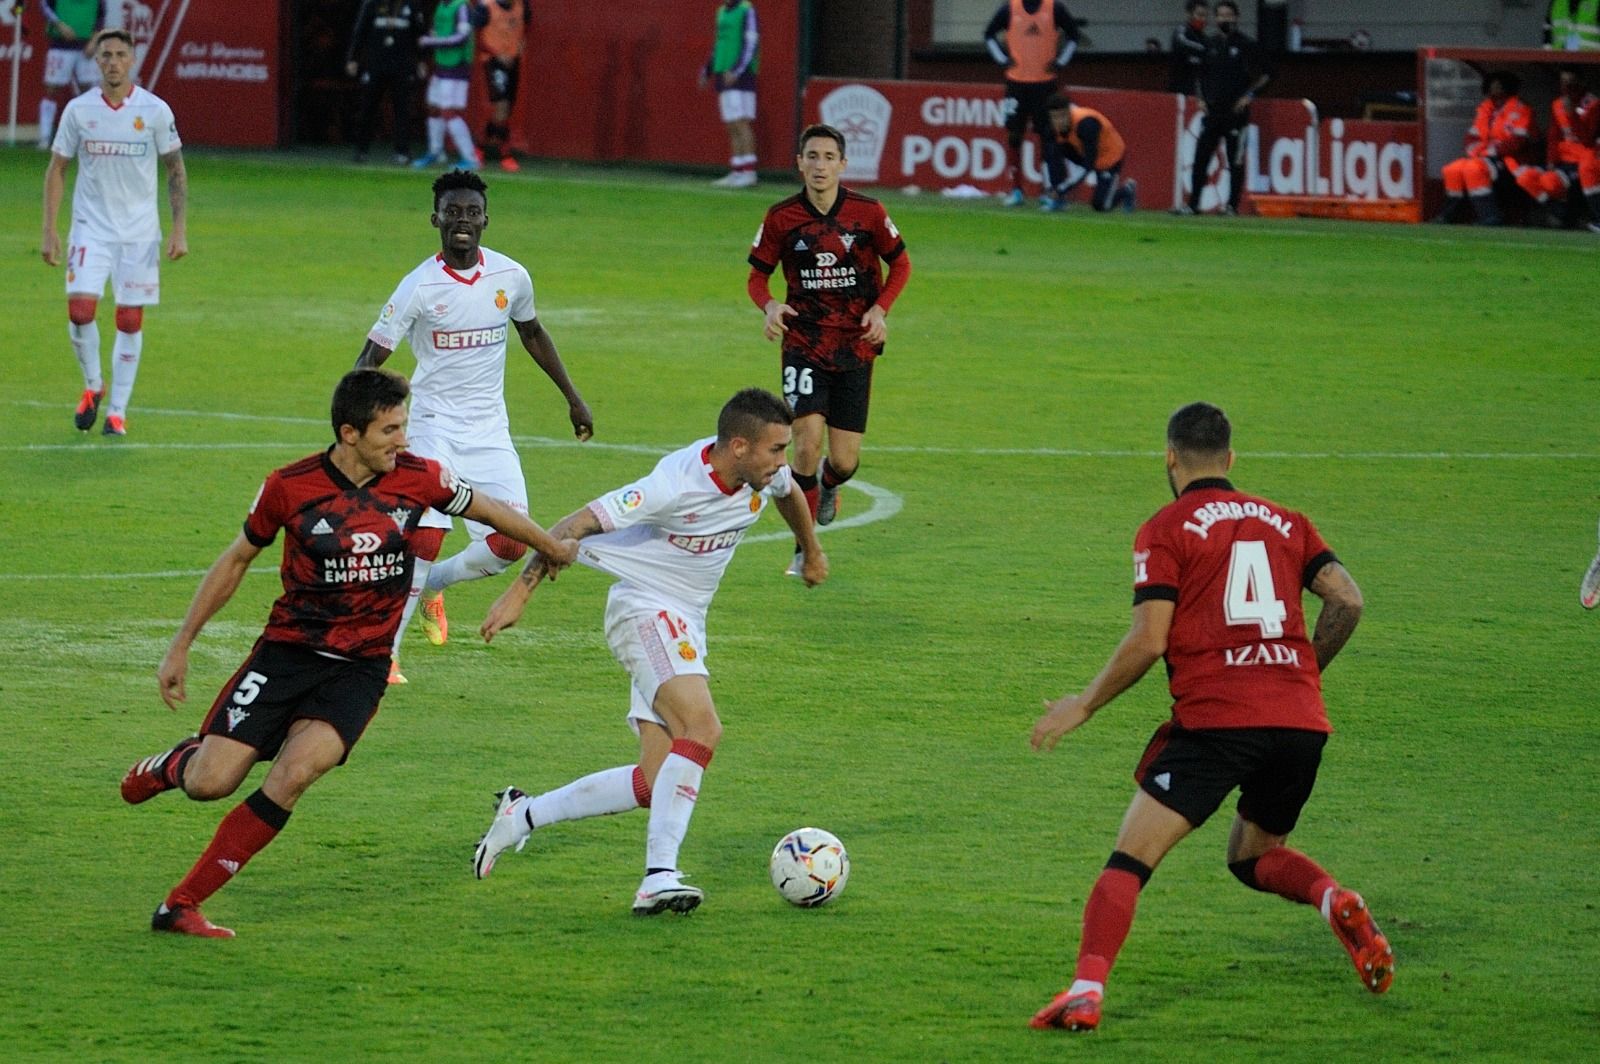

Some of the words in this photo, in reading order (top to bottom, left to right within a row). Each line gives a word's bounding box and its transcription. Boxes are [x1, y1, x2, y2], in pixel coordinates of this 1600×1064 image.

[921, 96, 1007, 127] GIMN
[86, 141, 147, 156] BETFRED
[1246, 117, 1414, 203] LaLiga
[800, 266, 857, 279] MIRANDA
[802, 276, 857, 290] EMPRESAS
[436, 330, 507, 349] BETFRED
[783, 366, 814, 395] 36
[671, 529, 746, 554] BETFR
[324, 551, 404, 569] MIRANDA
[325, 566, 404, 583] EMPRESAS
[1223, 540, 1288, 640] 4
[1225, 643, 1301, 669] IZADI
[232, 670, 268, 706] 5
